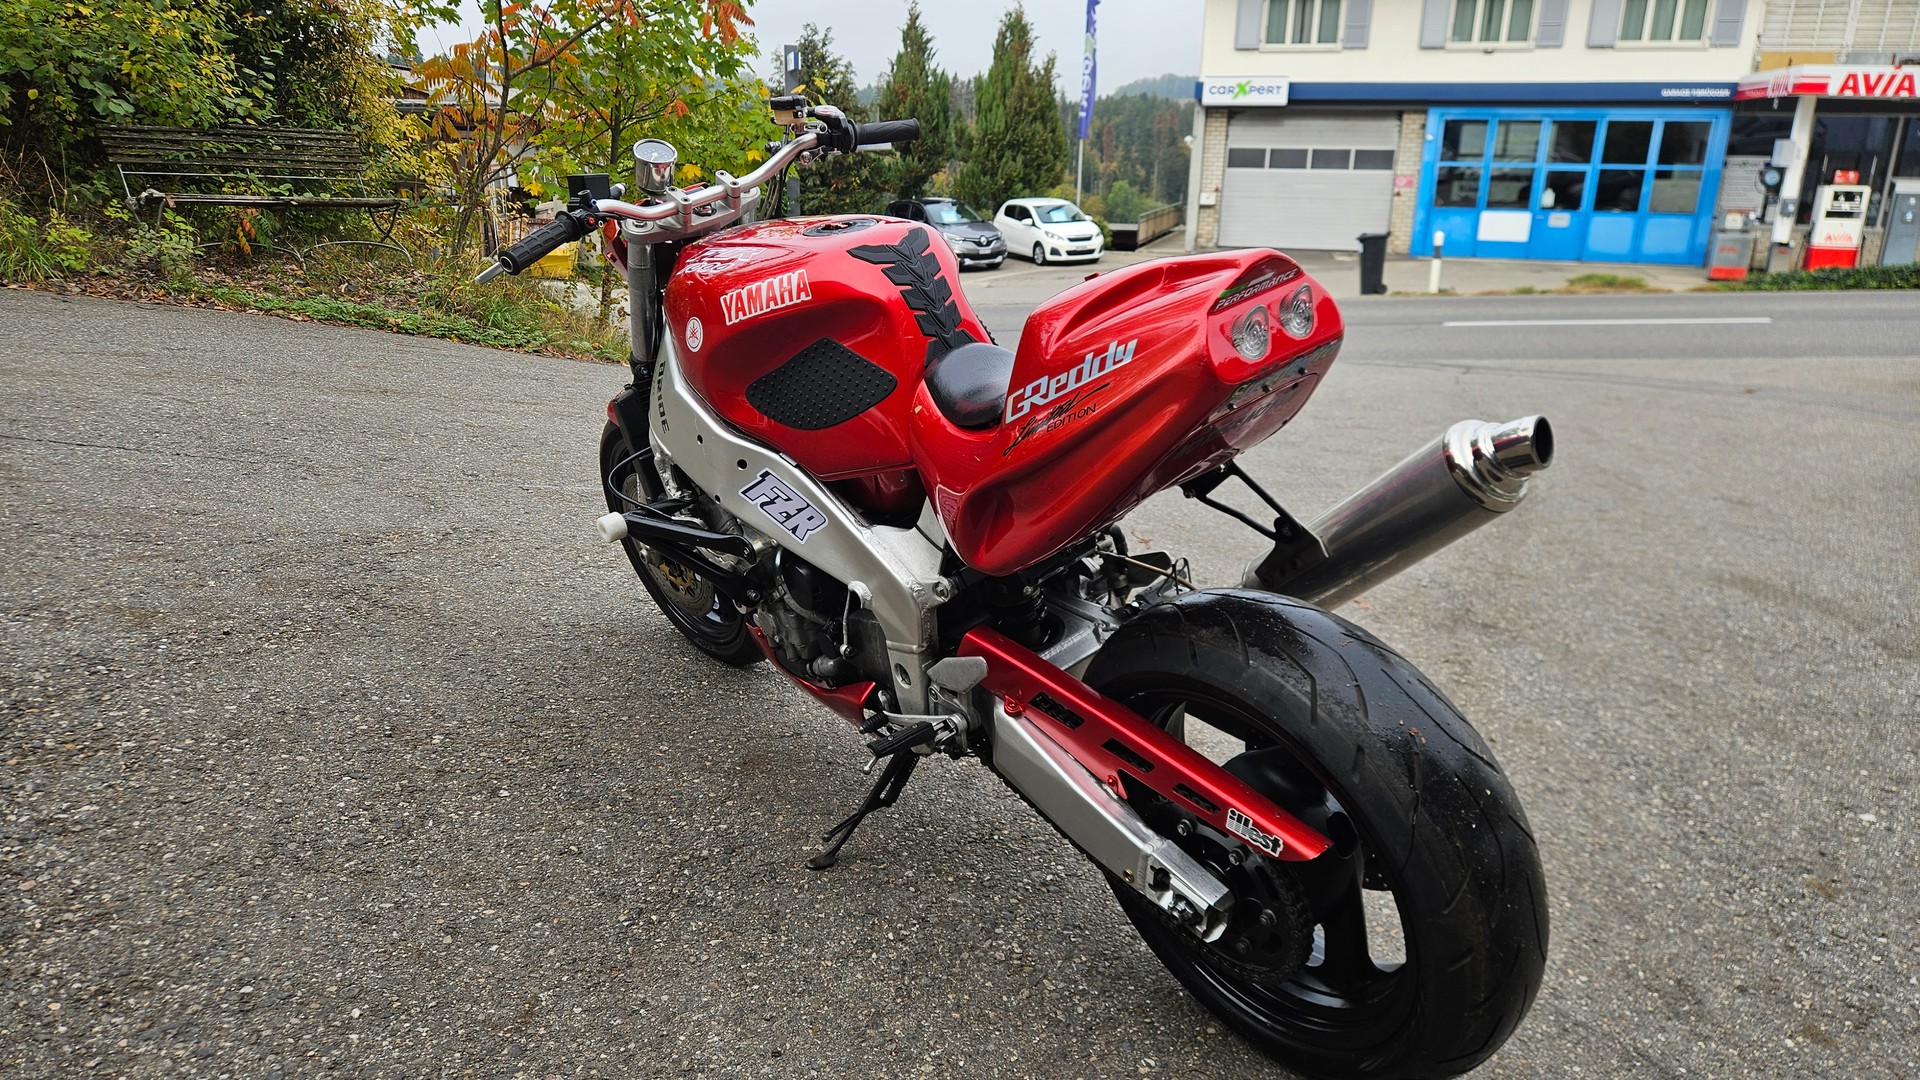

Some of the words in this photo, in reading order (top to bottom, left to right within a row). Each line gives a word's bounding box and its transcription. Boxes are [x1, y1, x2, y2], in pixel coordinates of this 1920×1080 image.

[1837, 72, 1917, 97] AVIA
[721, 270, 811, 323] YAMAHA
[1215, 268, 1299, 311] PERFORMANCE
[1006, 339, 1138, 424] GReddy
[1046, 404, 1097, 433] EDITION
[740, 469, 827, 542] FZR
[1228, 809, 1281, 855] illest
